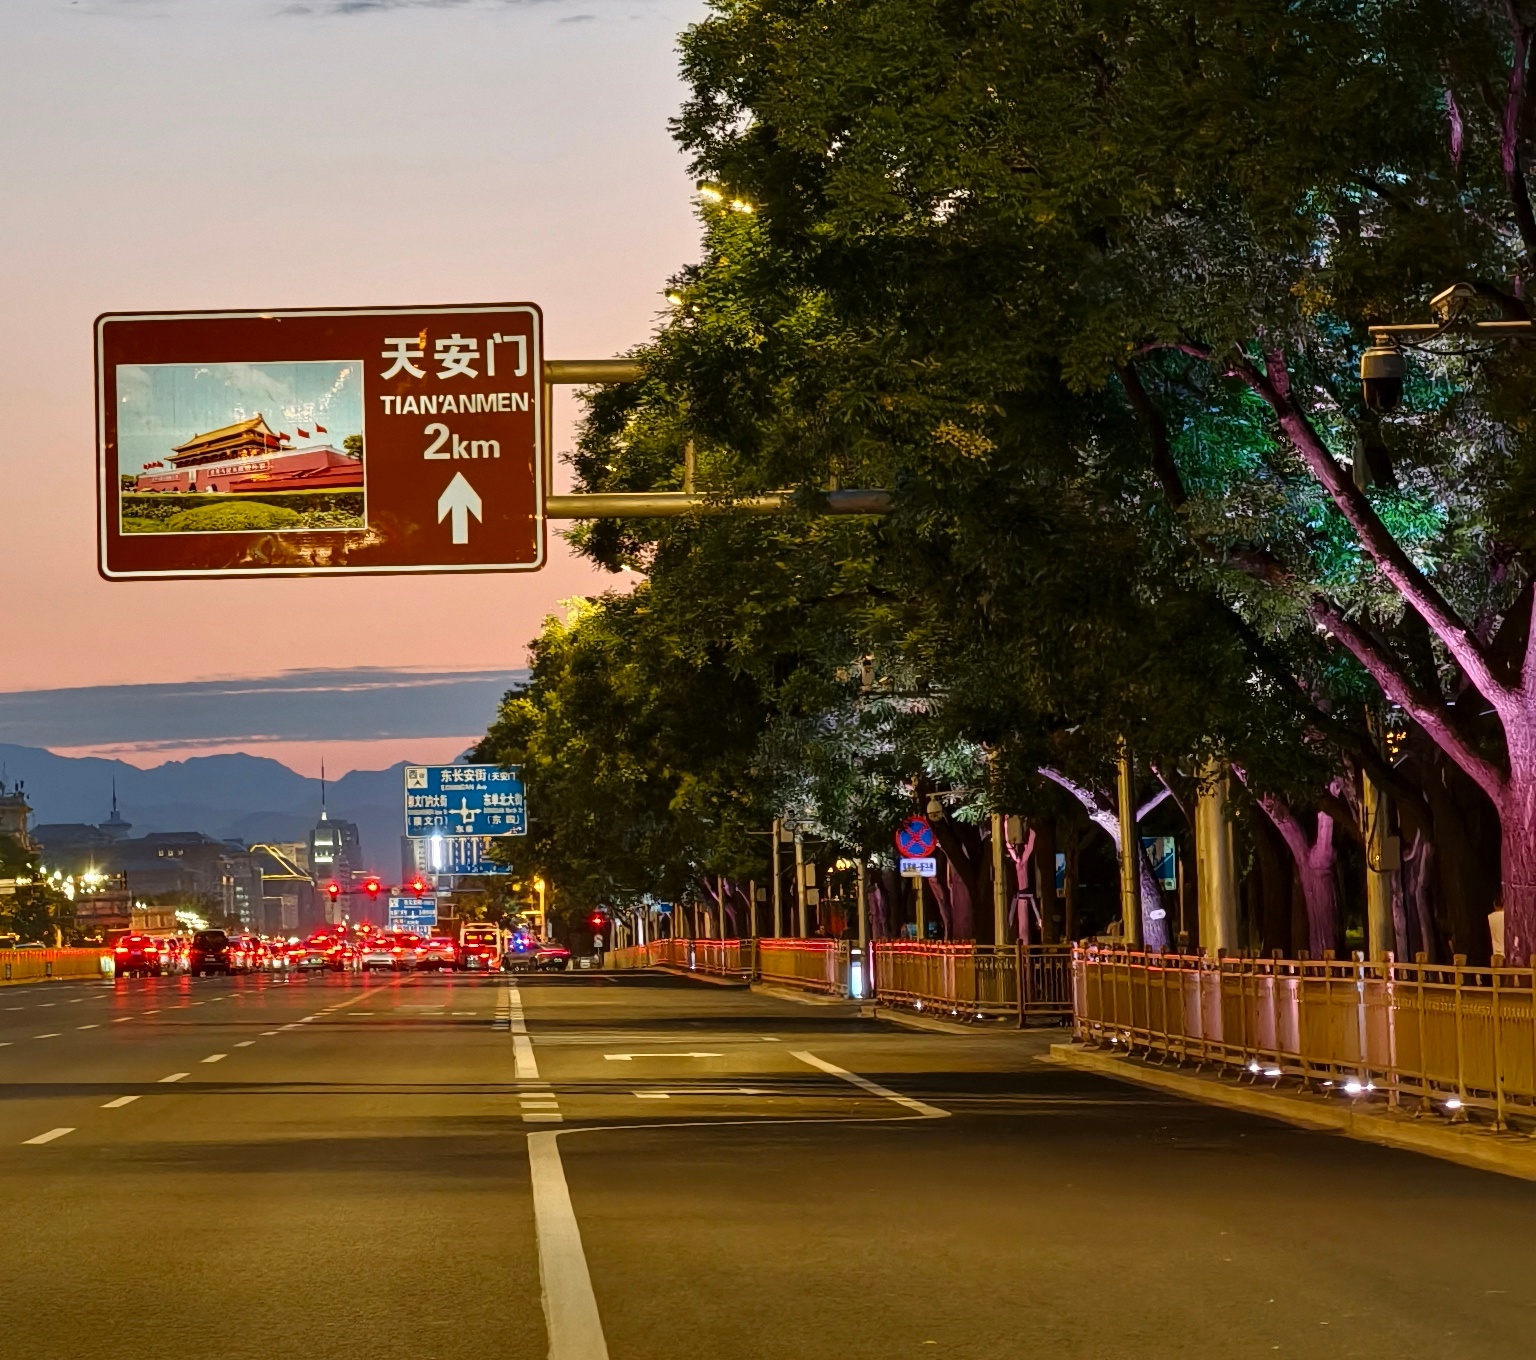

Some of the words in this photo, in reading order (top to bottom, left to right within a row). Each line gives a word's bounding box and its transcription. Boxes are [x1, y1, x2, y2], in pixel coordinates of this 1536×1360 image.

[379, 332, 528, 380] 天安门
[379, 392, 529, 415] TIAN'ANMEN
[423, 422, 501, 460] 2km
[440, 768, 487, 783] 东长安街
